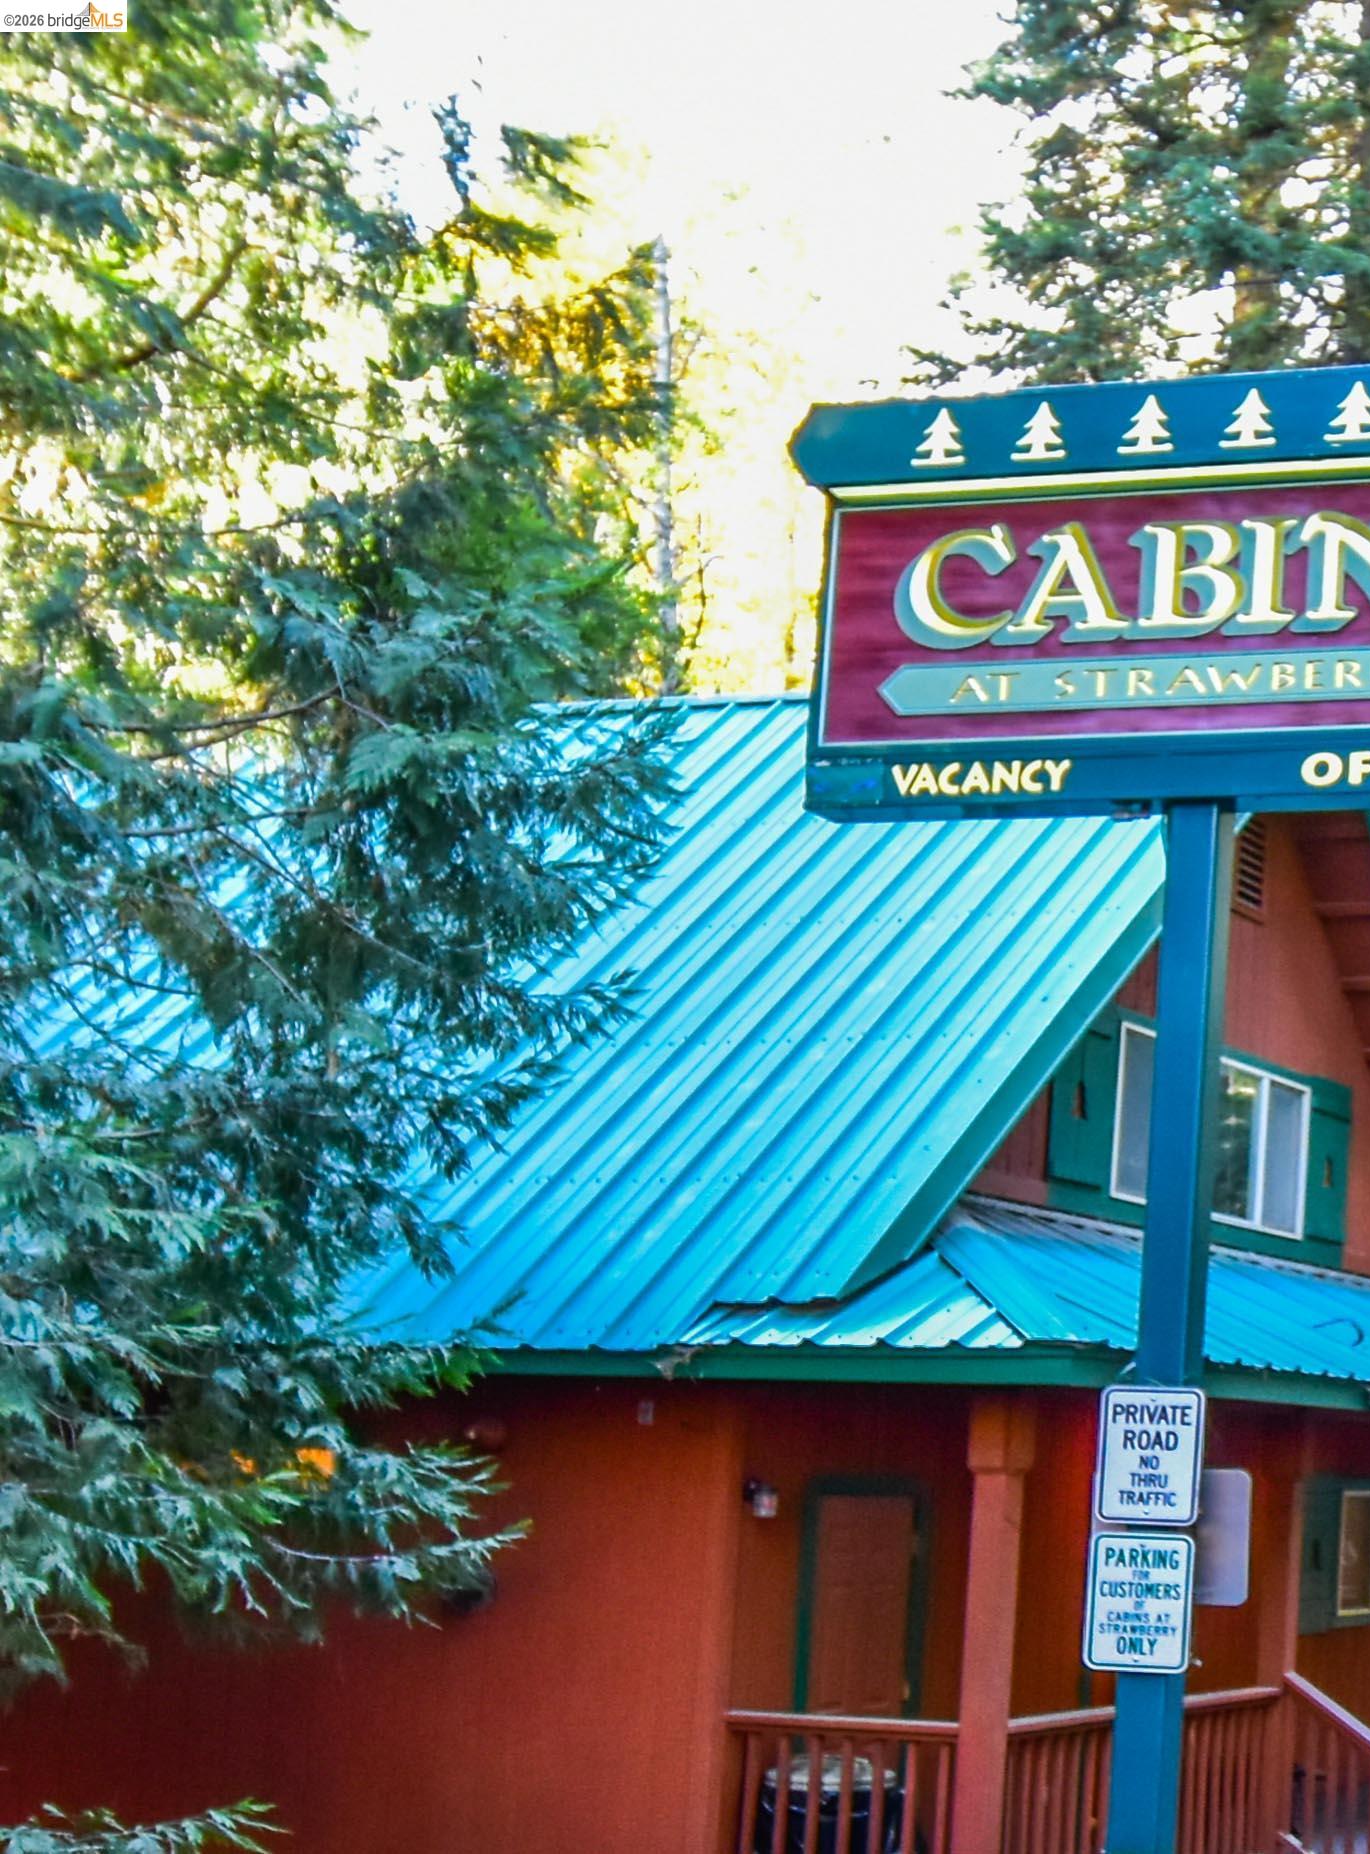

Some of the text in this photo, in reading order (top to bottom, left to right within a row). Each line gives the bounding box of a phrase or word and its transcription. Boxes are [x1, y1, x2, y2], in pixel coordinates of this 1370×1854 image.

[948, 672, 1020, 706] AT
[890, 758, 1072, 797] VACANCY
[1112, 1403, 1193, 1426] PRIVATE
[1122, 1429, 1179, 1451] ROAD
[1139, 1455, 1160, 1470] NO
[1130, 1472, 1168, 1488] THRU
[1118, 1490, 1177, 1507] TRAFFIC
[1104, 1547, 1180, 1570] PARKING
[1100, 1580, 1181, 1601] CUSTOMERS
[1107, 1611, 1171, 1624] CABINS AT
[1098, 1622, 1178, 1638] STRAWBERRY
[1116, 1635, 1158, 1656] ONLY
